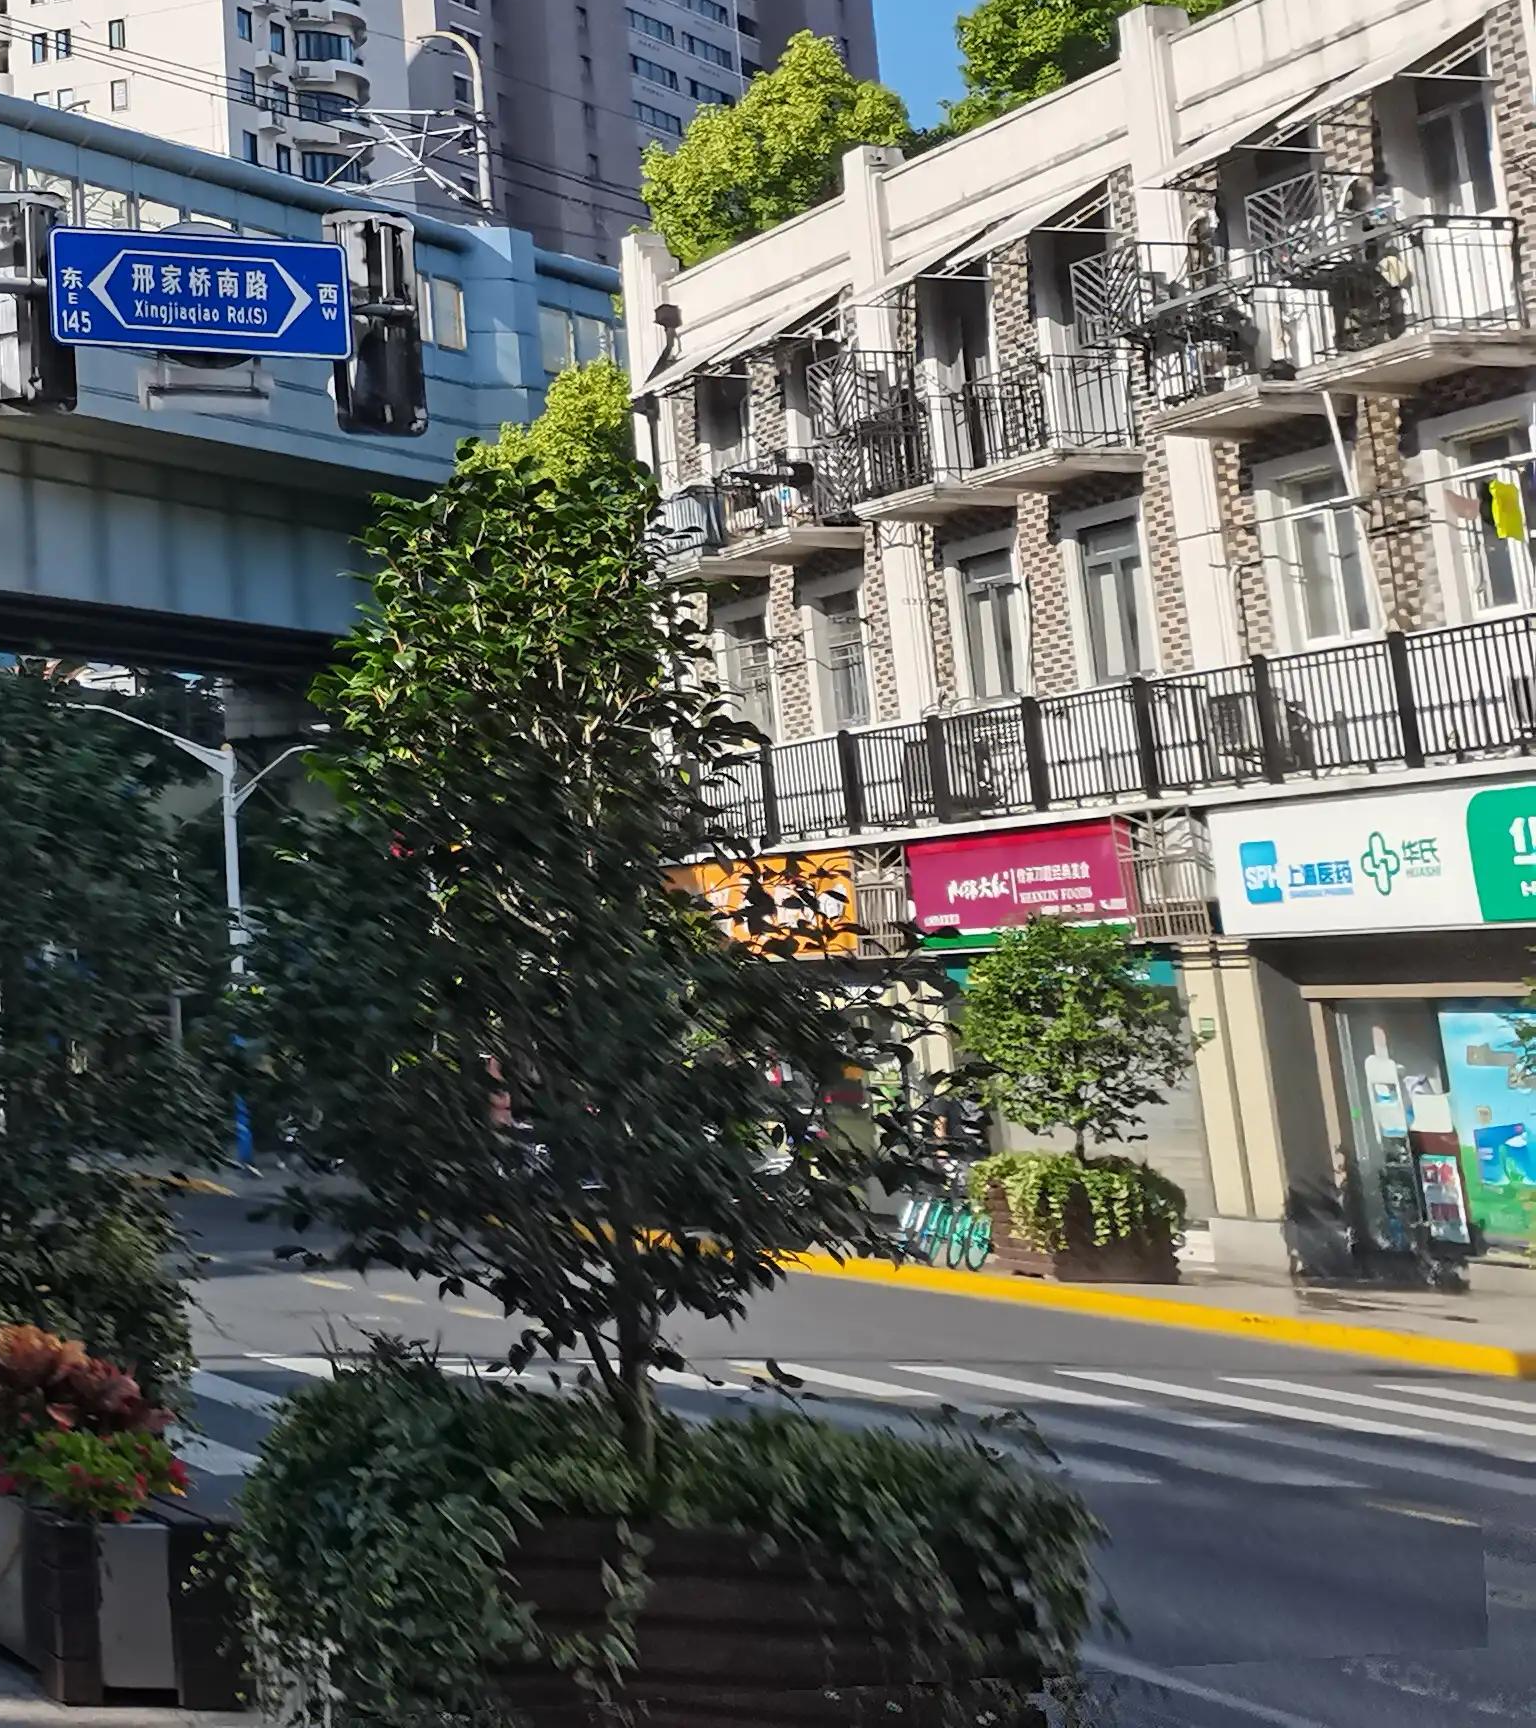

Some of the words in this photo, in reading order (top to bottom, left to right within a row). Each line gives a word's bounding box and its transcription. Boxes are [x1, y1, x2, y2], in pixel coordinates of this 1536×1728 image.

[60, 267, 84, 290] 东
[131, 262, 269, 302] 邢家桥南路
[68, 293, 79, 305] E
[316, 283, 340, 305] 西
[62, 309, 92, 334] 145
[134, 299, 221, 326] Xingjiaqiao
[227, 306, 268, 326] Rd.(S)
[321, 307, 338, 321] W
